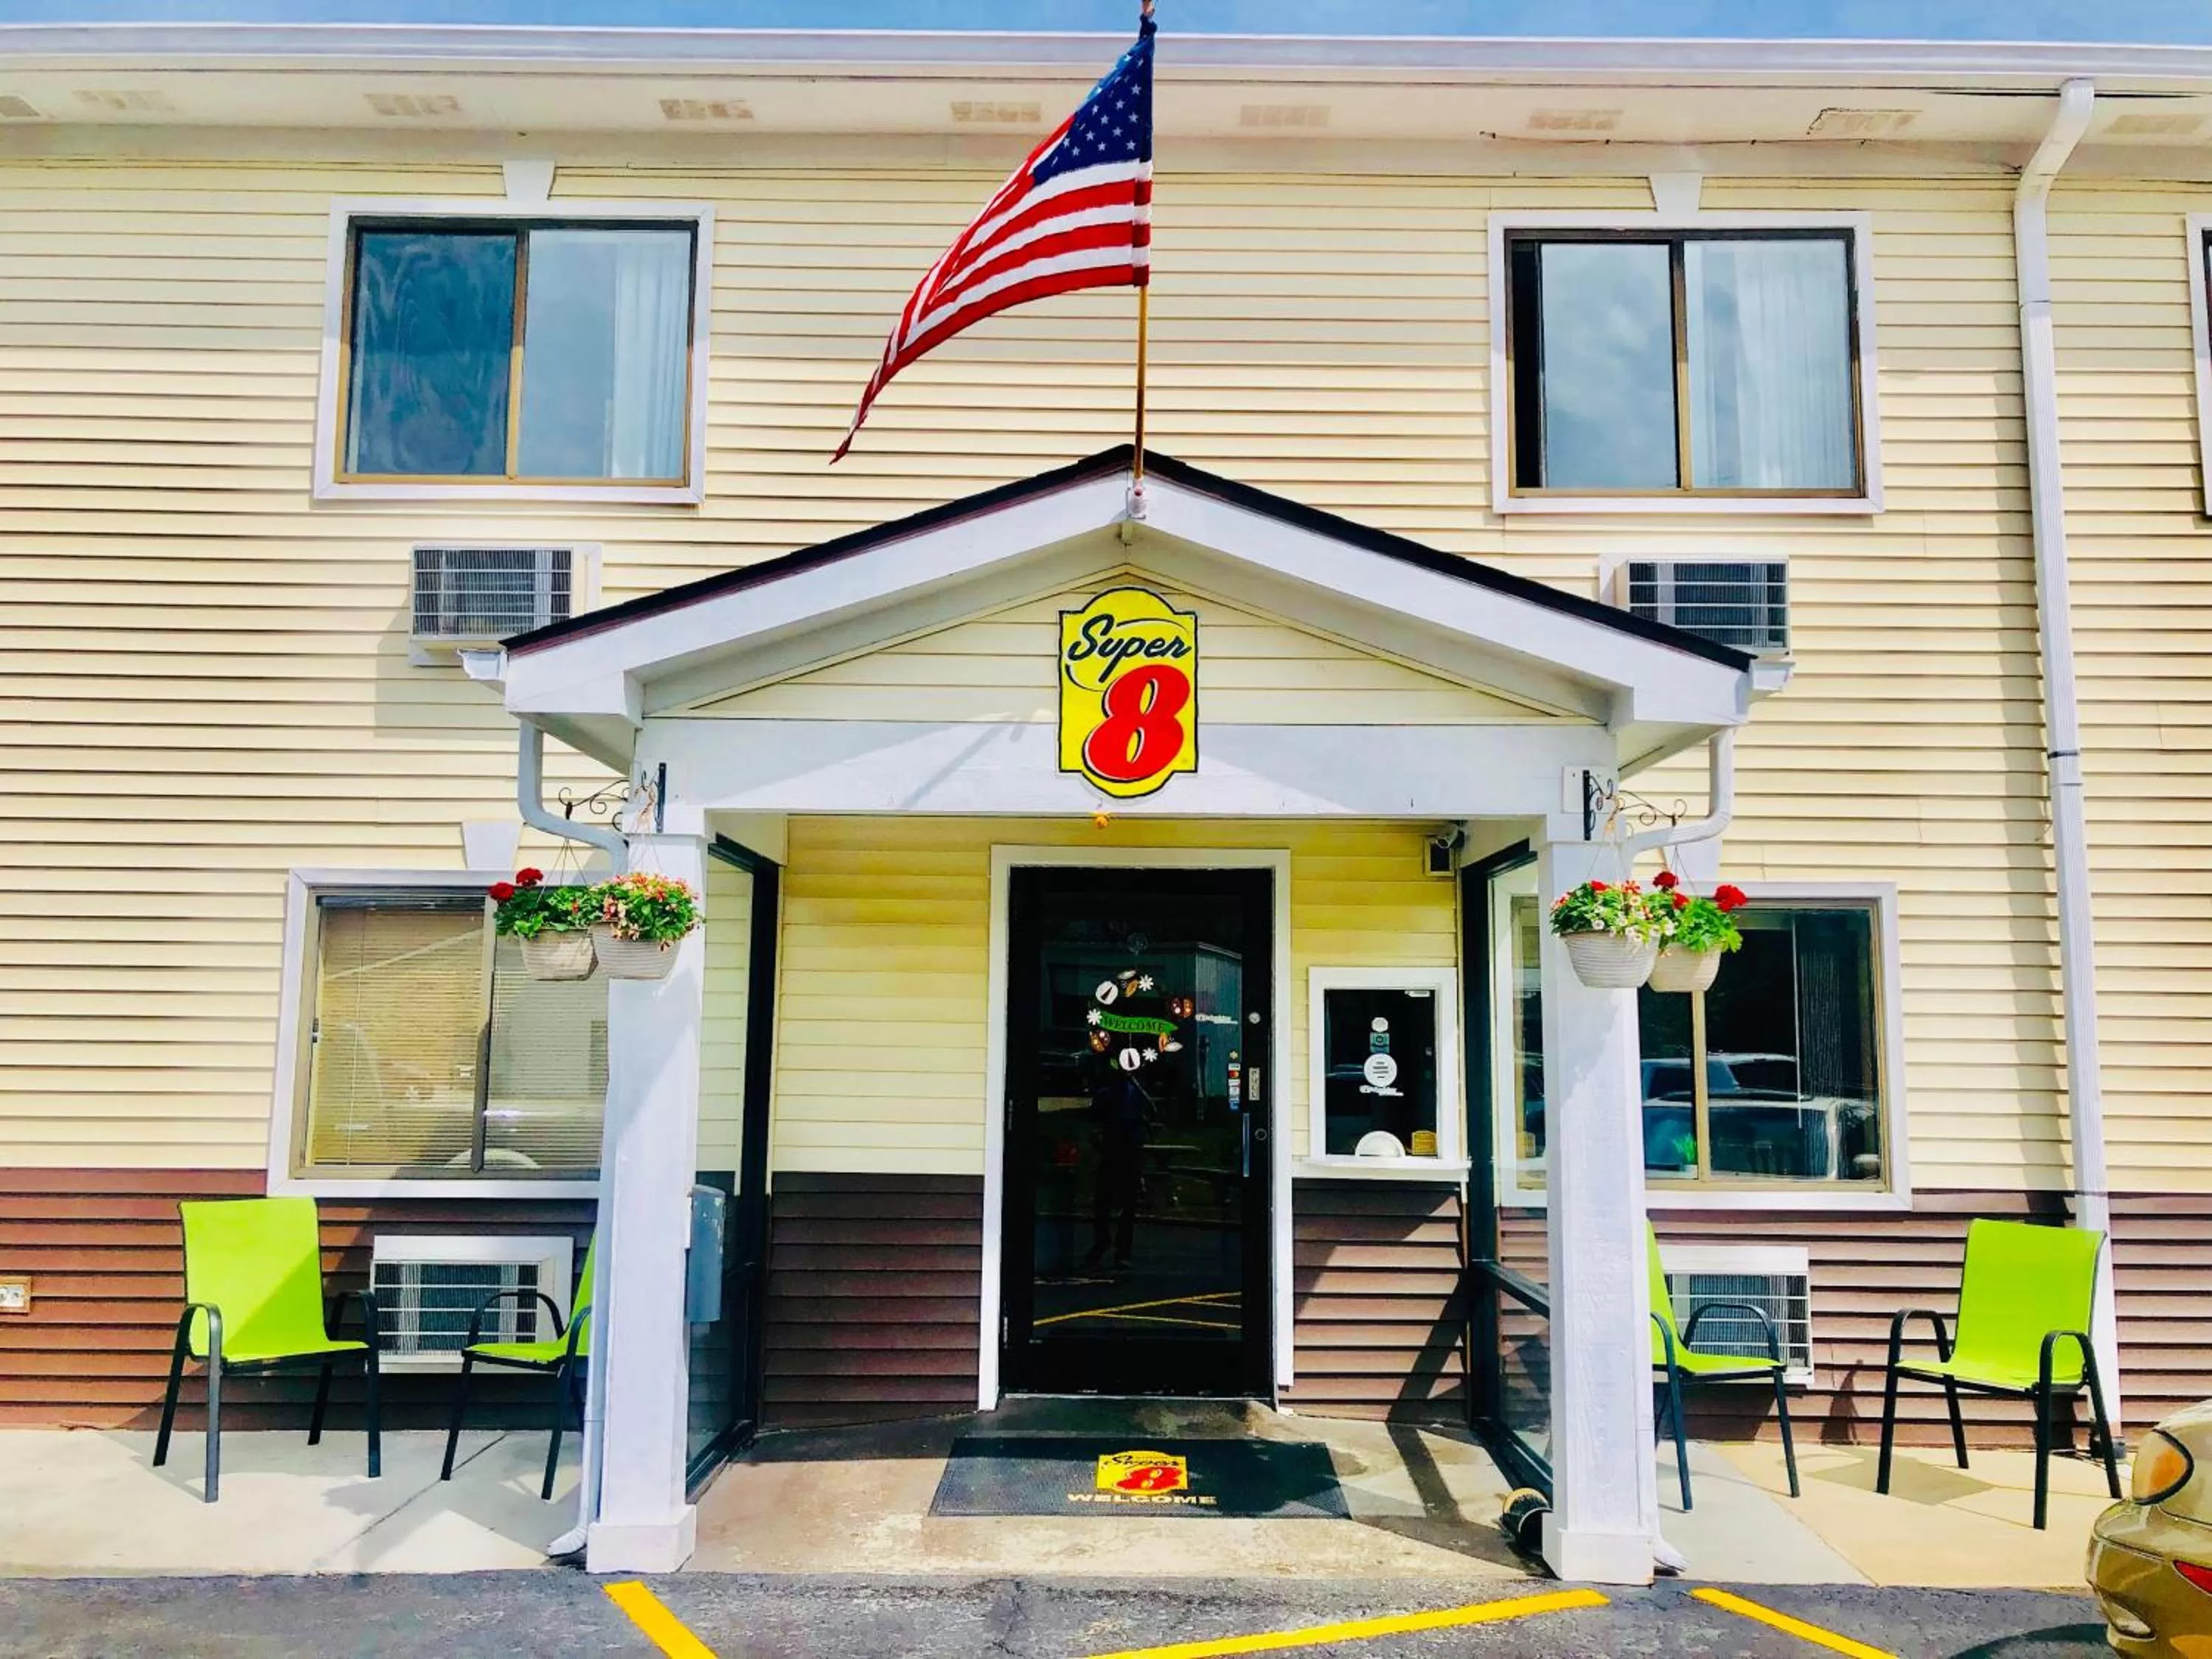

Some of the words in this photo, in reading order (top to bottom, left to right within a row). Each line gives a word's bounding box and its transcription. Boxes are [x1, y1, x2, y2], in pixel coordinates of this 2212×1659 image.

[1068, 613, 1192, 683] Super
[1082, 664, 1190, 783] 8
[1103, 1015, 1165, 1032] WELCOME
[1114, 1466, 1182, 1491] 8
[1067, 1493, 1217, 1505] WELCOME
